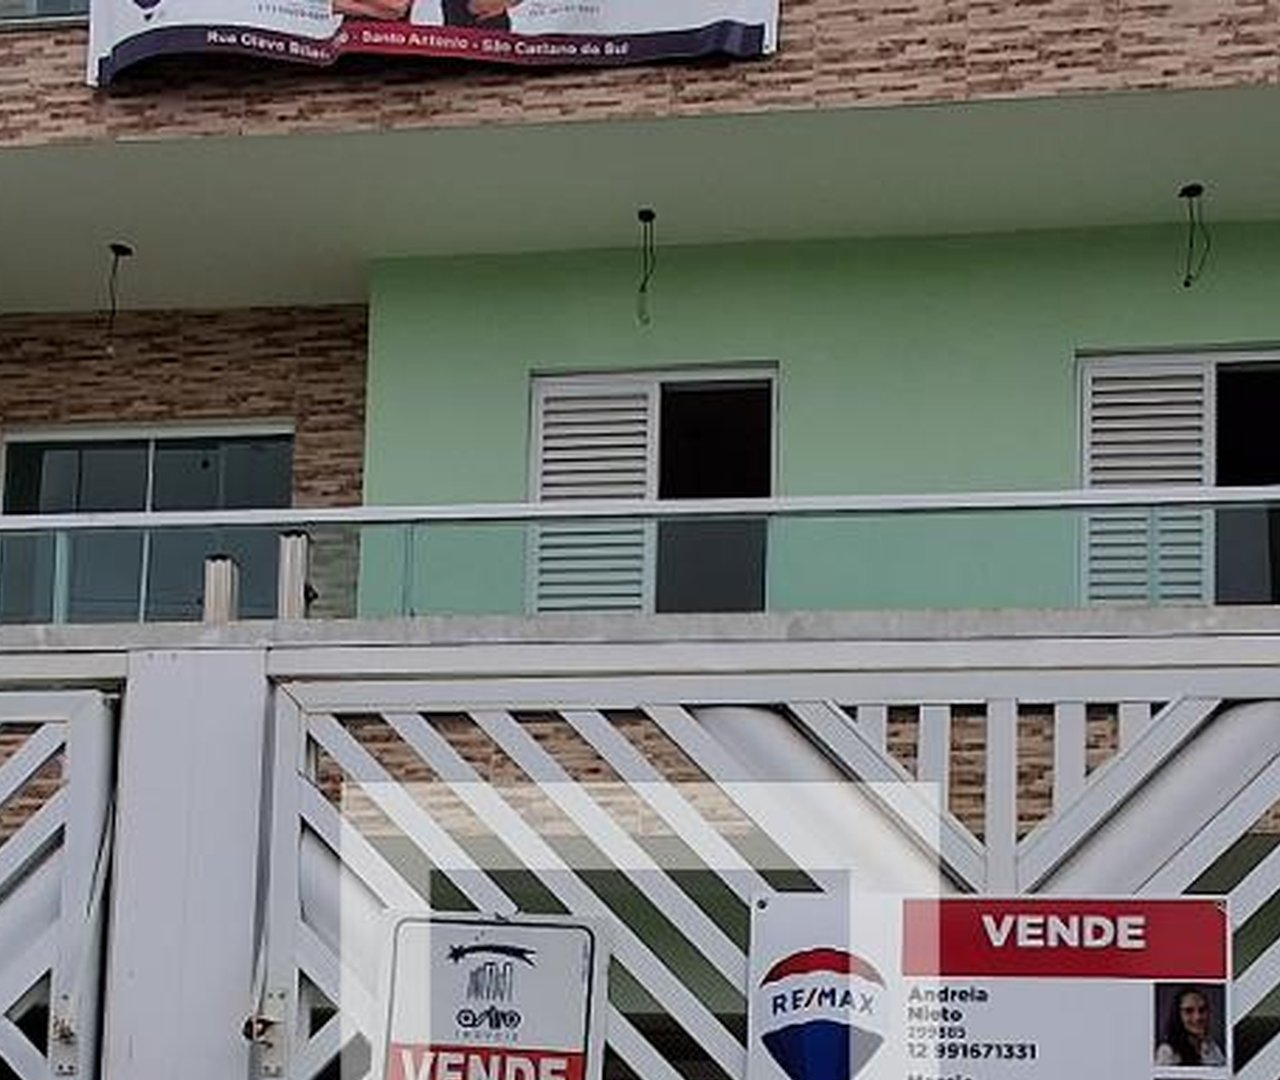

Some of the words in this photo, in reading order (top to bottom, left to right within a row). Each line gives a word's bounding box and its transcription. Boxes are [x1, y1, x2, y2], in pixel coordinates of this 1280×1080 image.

[982, 914, 1146, 949] VENDE
[772, 986, 874, 1016] RE/MAX
[908, 1043, 927, 1058] 12
[934, 1043, 1036, 1060] 991671331
